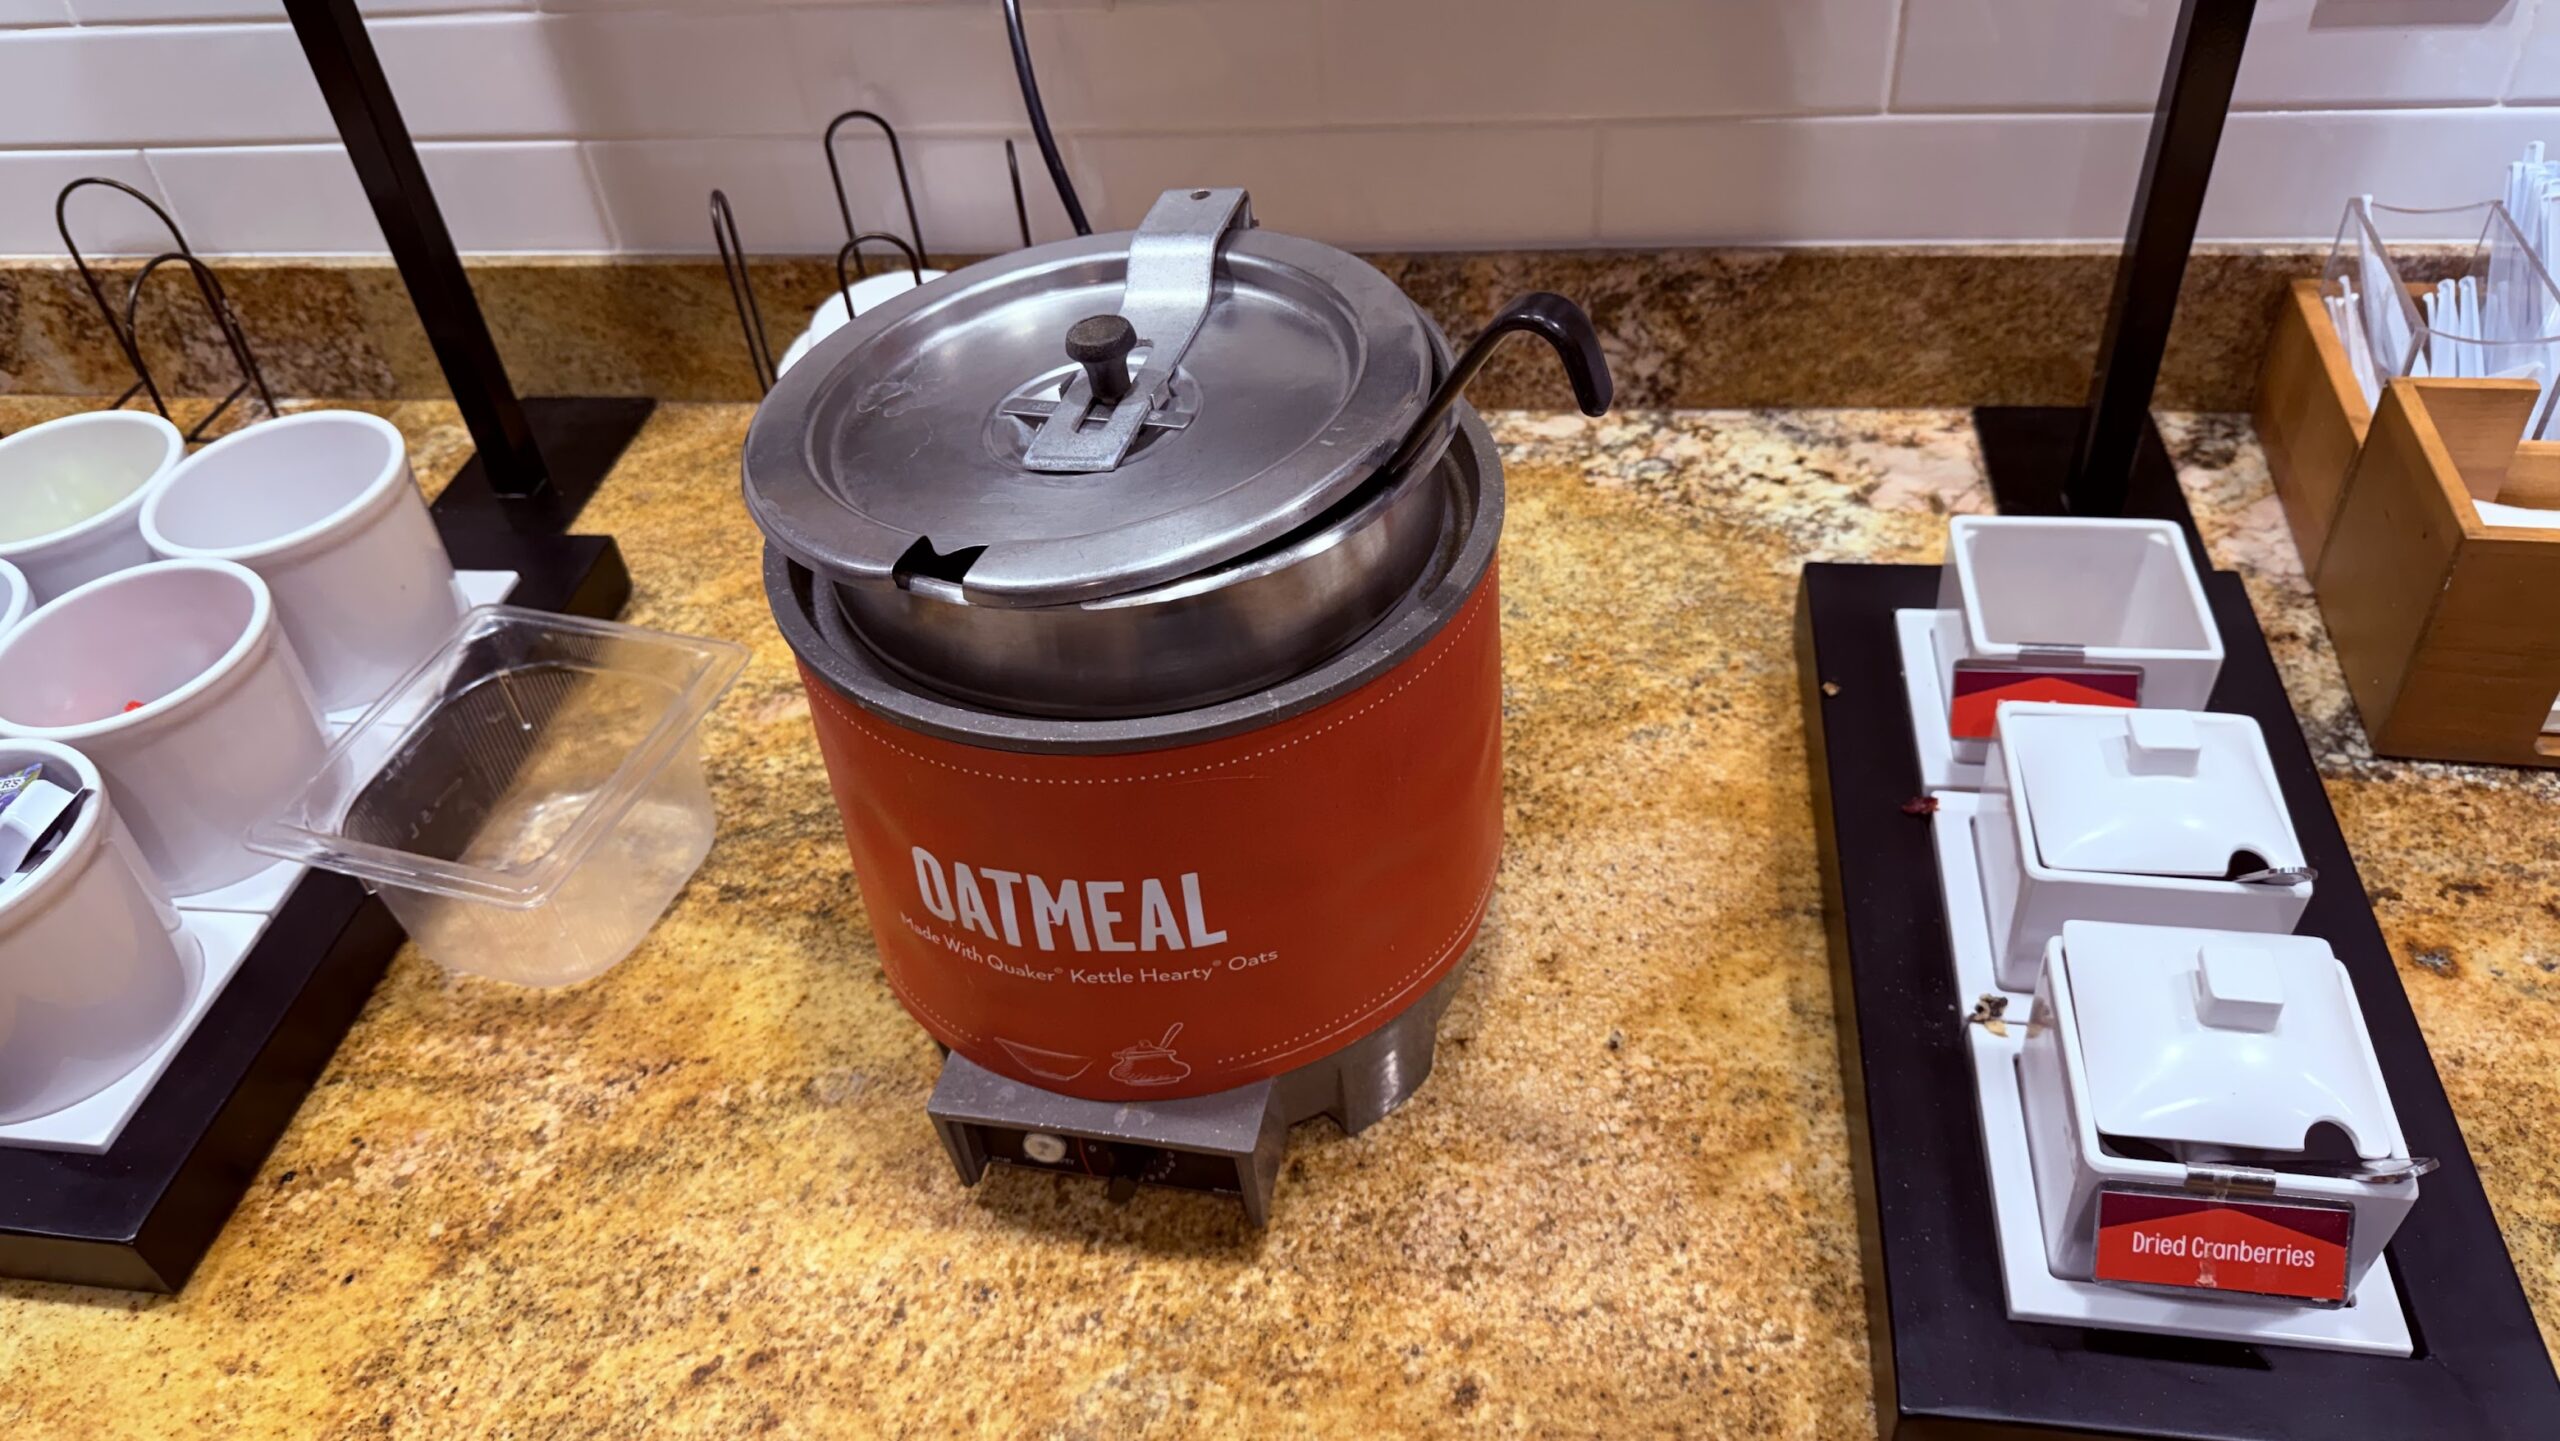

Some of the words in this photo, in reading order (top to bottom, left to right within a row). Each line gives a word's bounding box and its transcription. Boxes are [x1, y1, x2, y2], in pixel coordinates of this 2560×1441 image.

[912, 846, 1228, 952] OATMEAL
[900, 911, 941, 944] Made
[943, 934, 983, 964] With
[1070, 967, 1134, 984] Kettle
[1228, 950, 1278, 971] Oats
[2132, 1231, 2187, 1257] Dried
[2191, 1236, 2315, 1268] Cranberries
